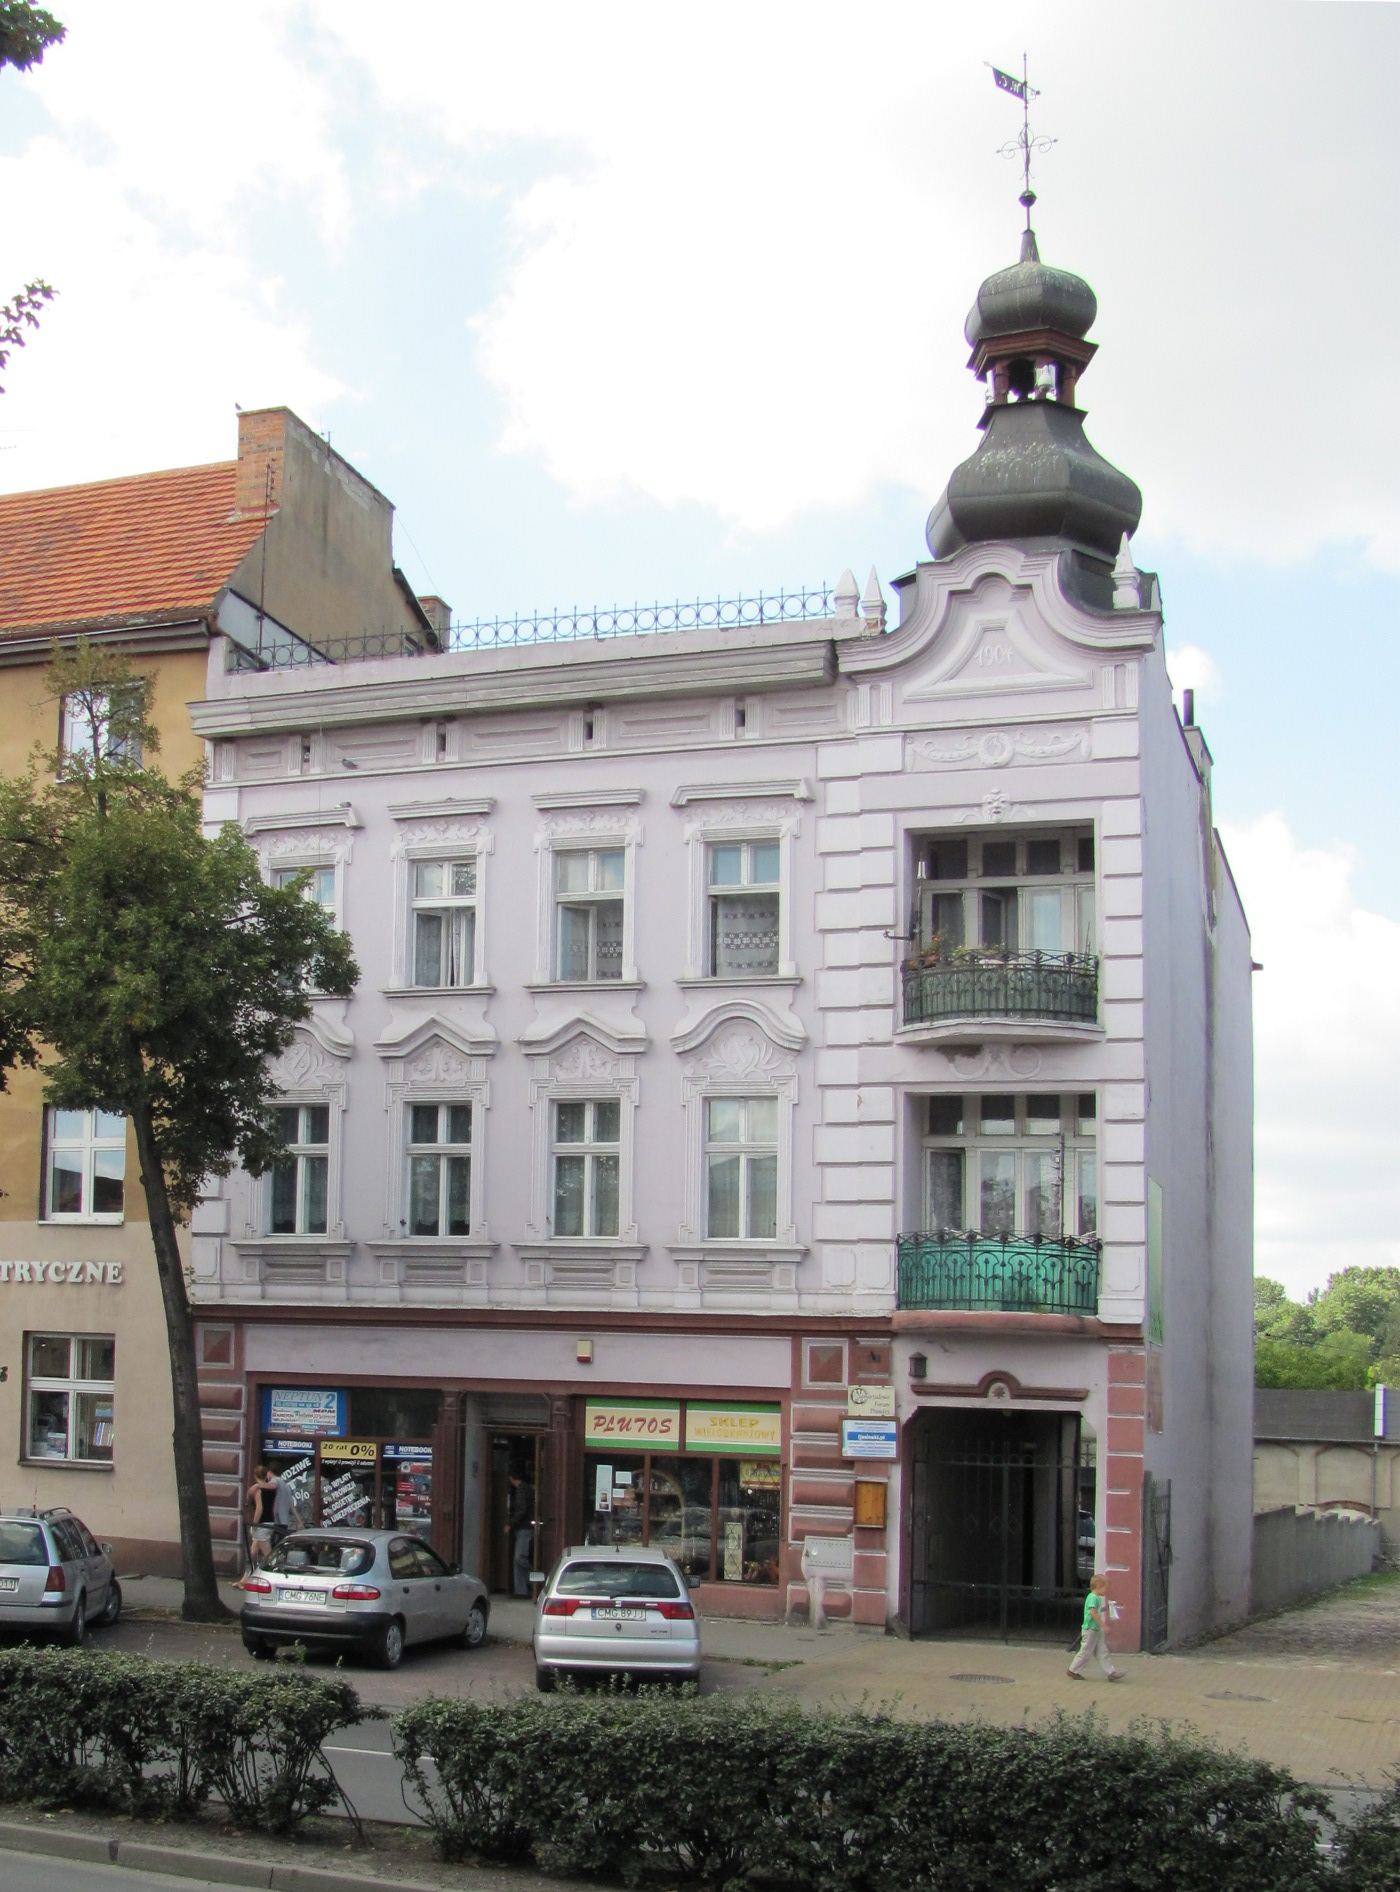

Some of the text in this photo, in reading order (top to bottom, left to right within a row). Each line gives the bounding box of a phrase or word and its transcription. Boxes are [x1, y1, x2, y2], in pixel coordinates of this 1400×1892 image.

[0, 1261, 122, 1284] TRYCZNE
[274, 1391, 322, 1401] NEPTUN
[325, 1392, 336, 1409] 2
[593, 1415, 673, 1434] PLUTOS
[709, 1416, 760, 1428] SKLEP
[350, 1444, 375, 1457] 0%
[598, 1609, 619, 1618] CMG
